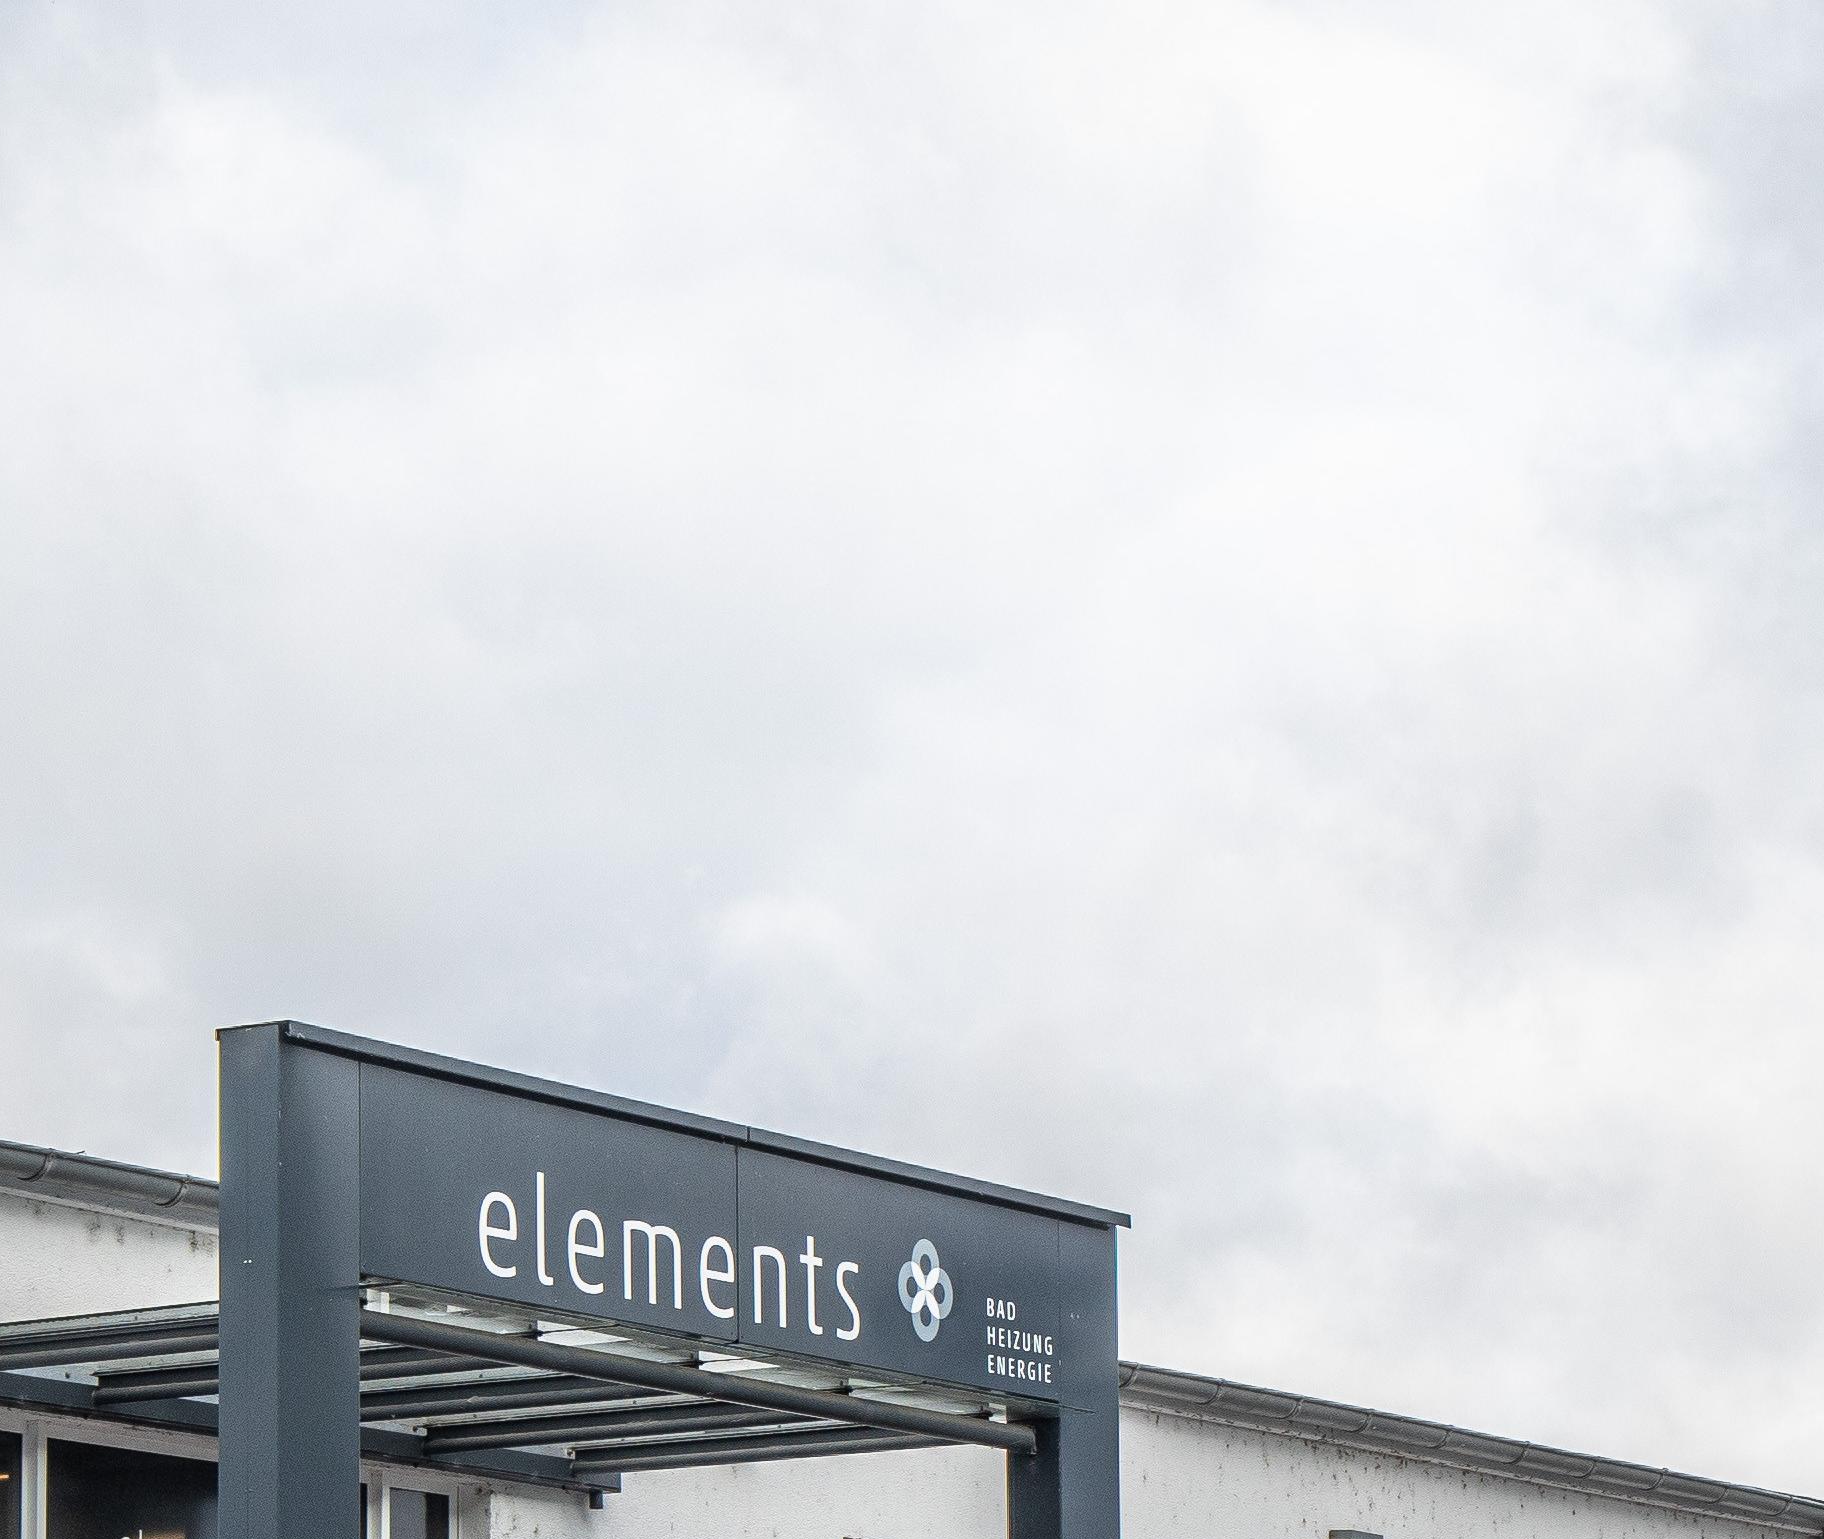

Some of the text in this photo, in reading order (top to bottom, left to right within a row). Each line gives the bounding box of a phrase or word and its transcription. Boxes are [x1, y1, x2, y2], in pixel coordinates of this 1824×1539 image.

[479, 1172, 861, 1342] elements
[987, 1297, 1016, 1322] BAD
[987, 1326, 1054, 1357] HEIZUNG
[987, 1355, 1053, 1384] ENERGIE
